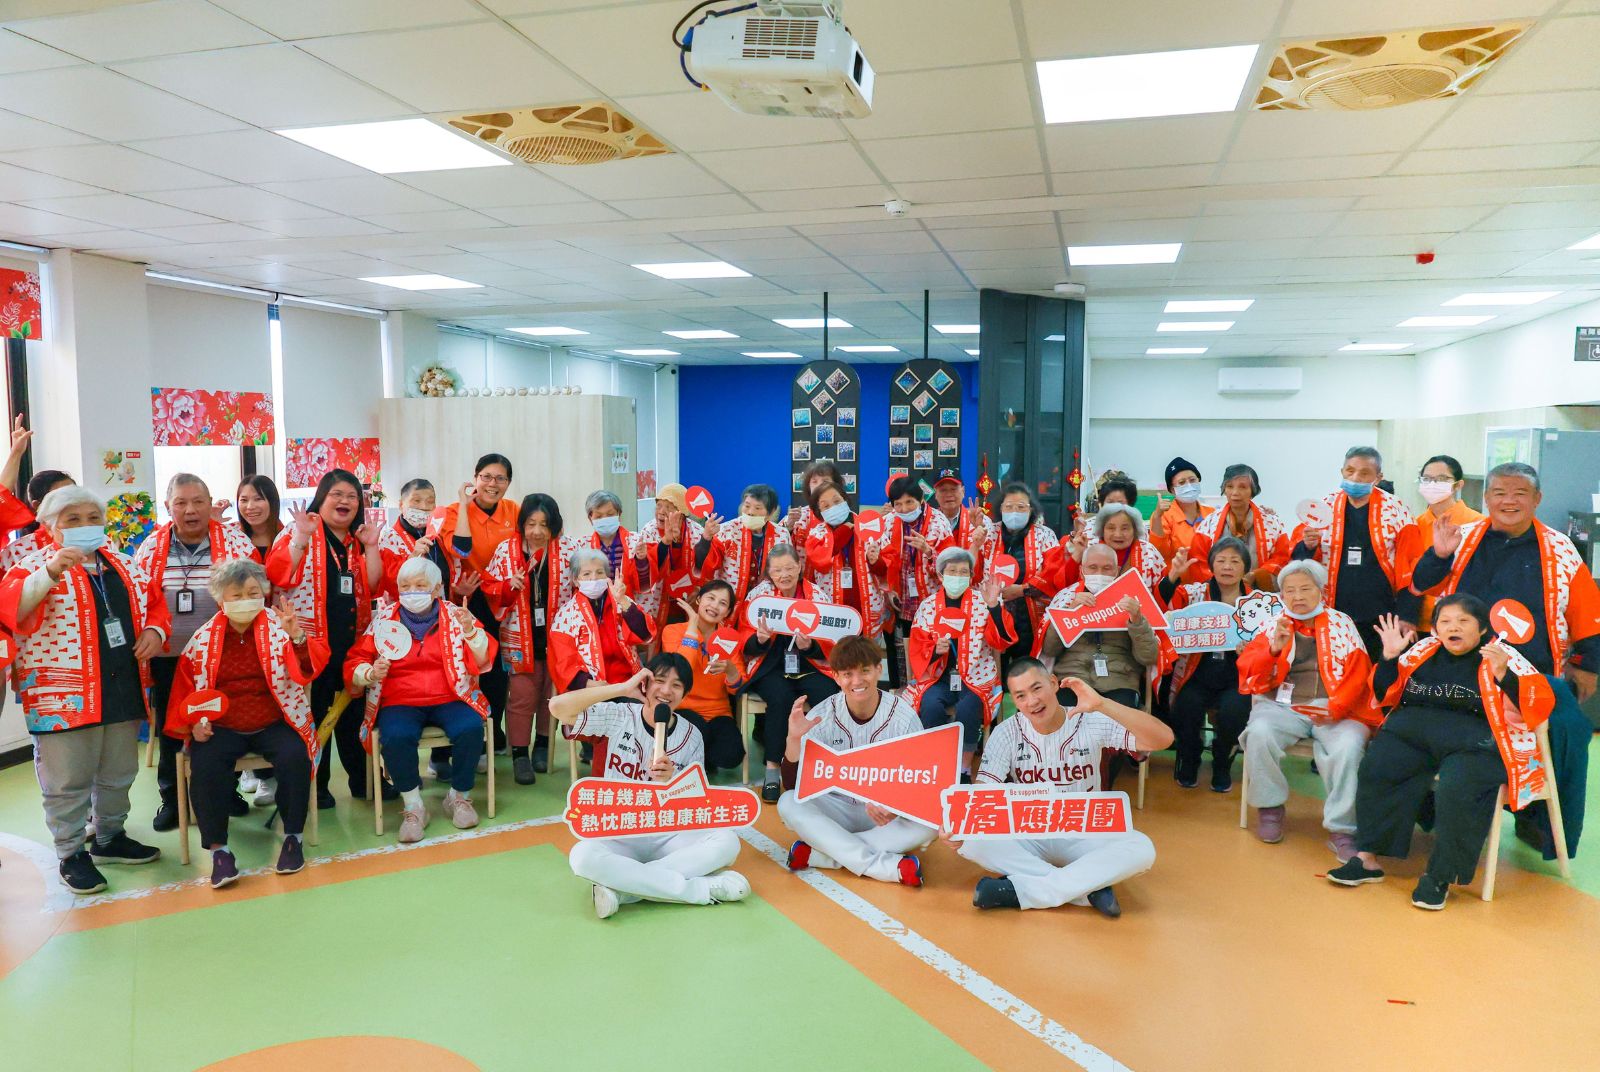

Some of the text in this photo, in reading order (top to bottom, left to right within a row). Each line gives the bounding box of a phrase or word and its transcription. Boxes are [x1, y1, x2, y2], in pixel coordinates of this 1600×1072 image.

[1063, 617, 1079, 630] Be
[1174, 615, 1230, 632] 健康支援
[1170, 632, 1226, 648] 如影隨形
[814, 759, 938, 786] Be supporters!
[1015, 763, 1094, 784] Rakuten
[577, 787, 653, 806] 無論幾歲
[1018, 788, 1050, 797] supporters!
[581, 804, 749, 832] 熱忱應援健康新生活
